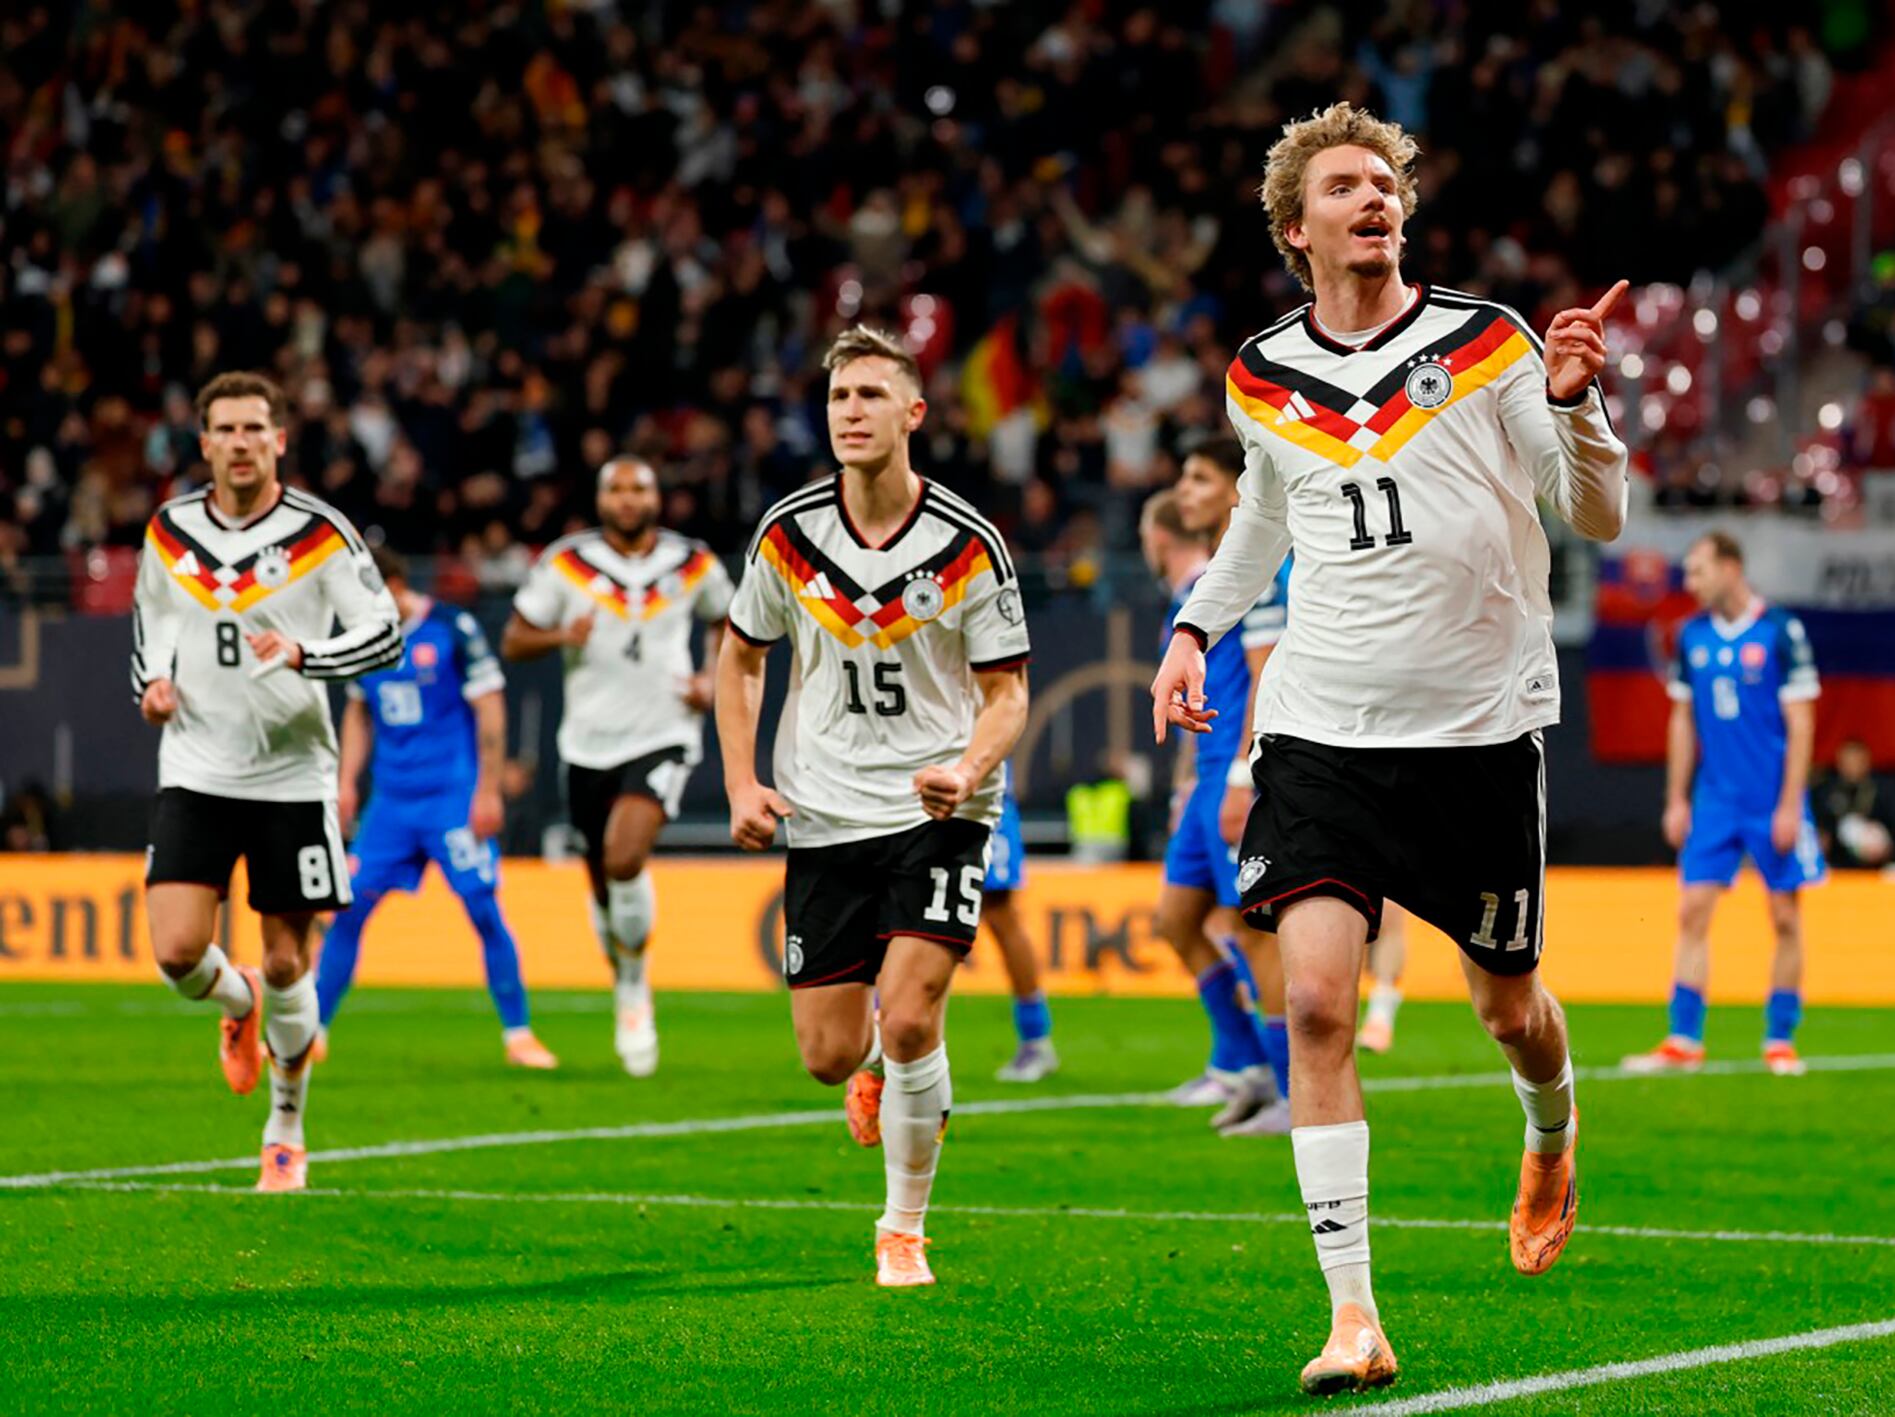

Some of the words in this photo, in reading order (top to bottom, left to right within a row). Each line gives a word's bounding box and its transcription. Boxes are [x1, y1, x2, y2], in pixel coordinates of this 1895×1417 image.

[1340, 477, 1413, 551] 11
[216, 621, 241, 667] 8
[623, 632, 643, 663] 4
[842, 660, 906, 716] 15
[298, 845, 332, 900] 8
[924, 864, 984, 927] 15
[1470, 888, 1529, 951] 11
